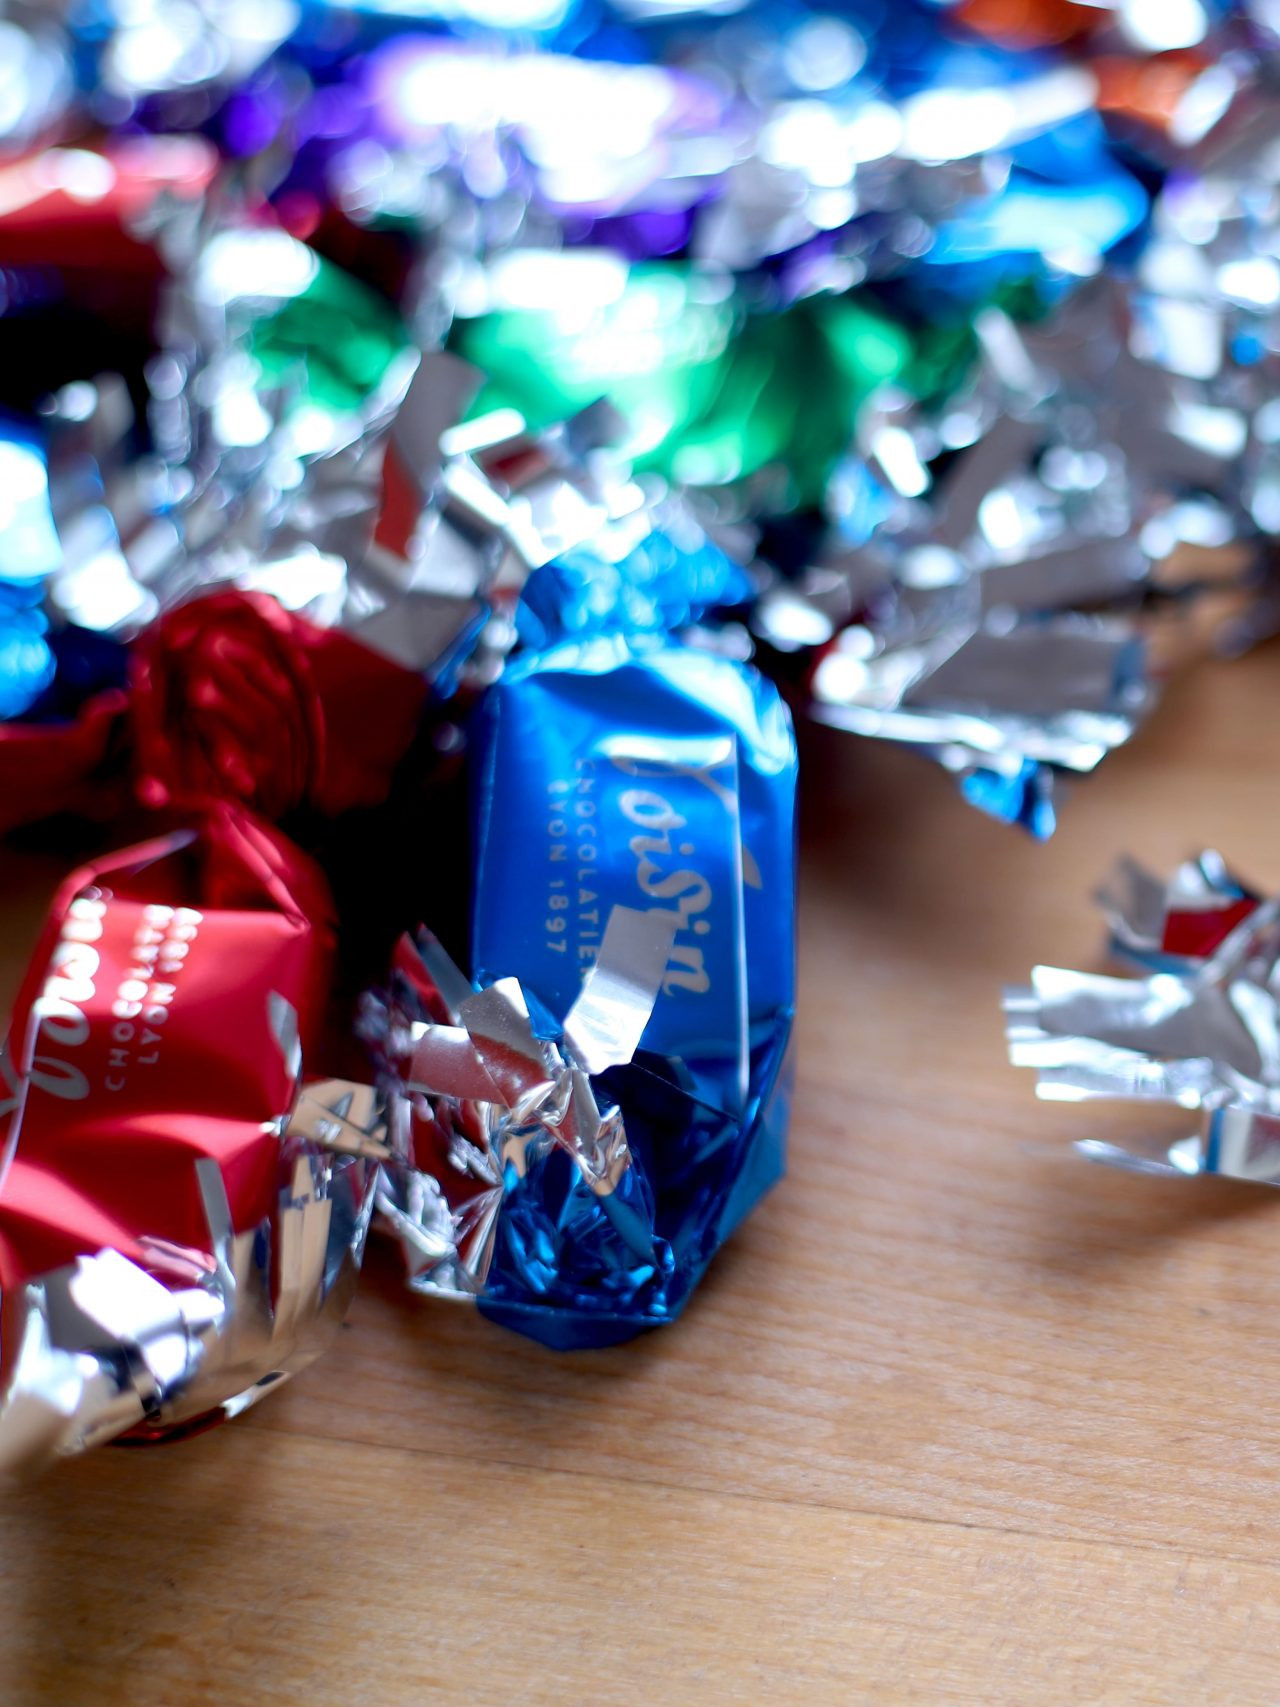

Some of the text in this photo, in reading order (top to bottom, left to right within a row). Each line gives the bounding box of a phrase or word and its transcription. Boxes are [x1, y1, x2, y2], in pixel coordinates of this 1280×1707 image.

[545, 779, 570, 954] LYON 1897
[574, 757, 601, 978] CHOCOLATIE
